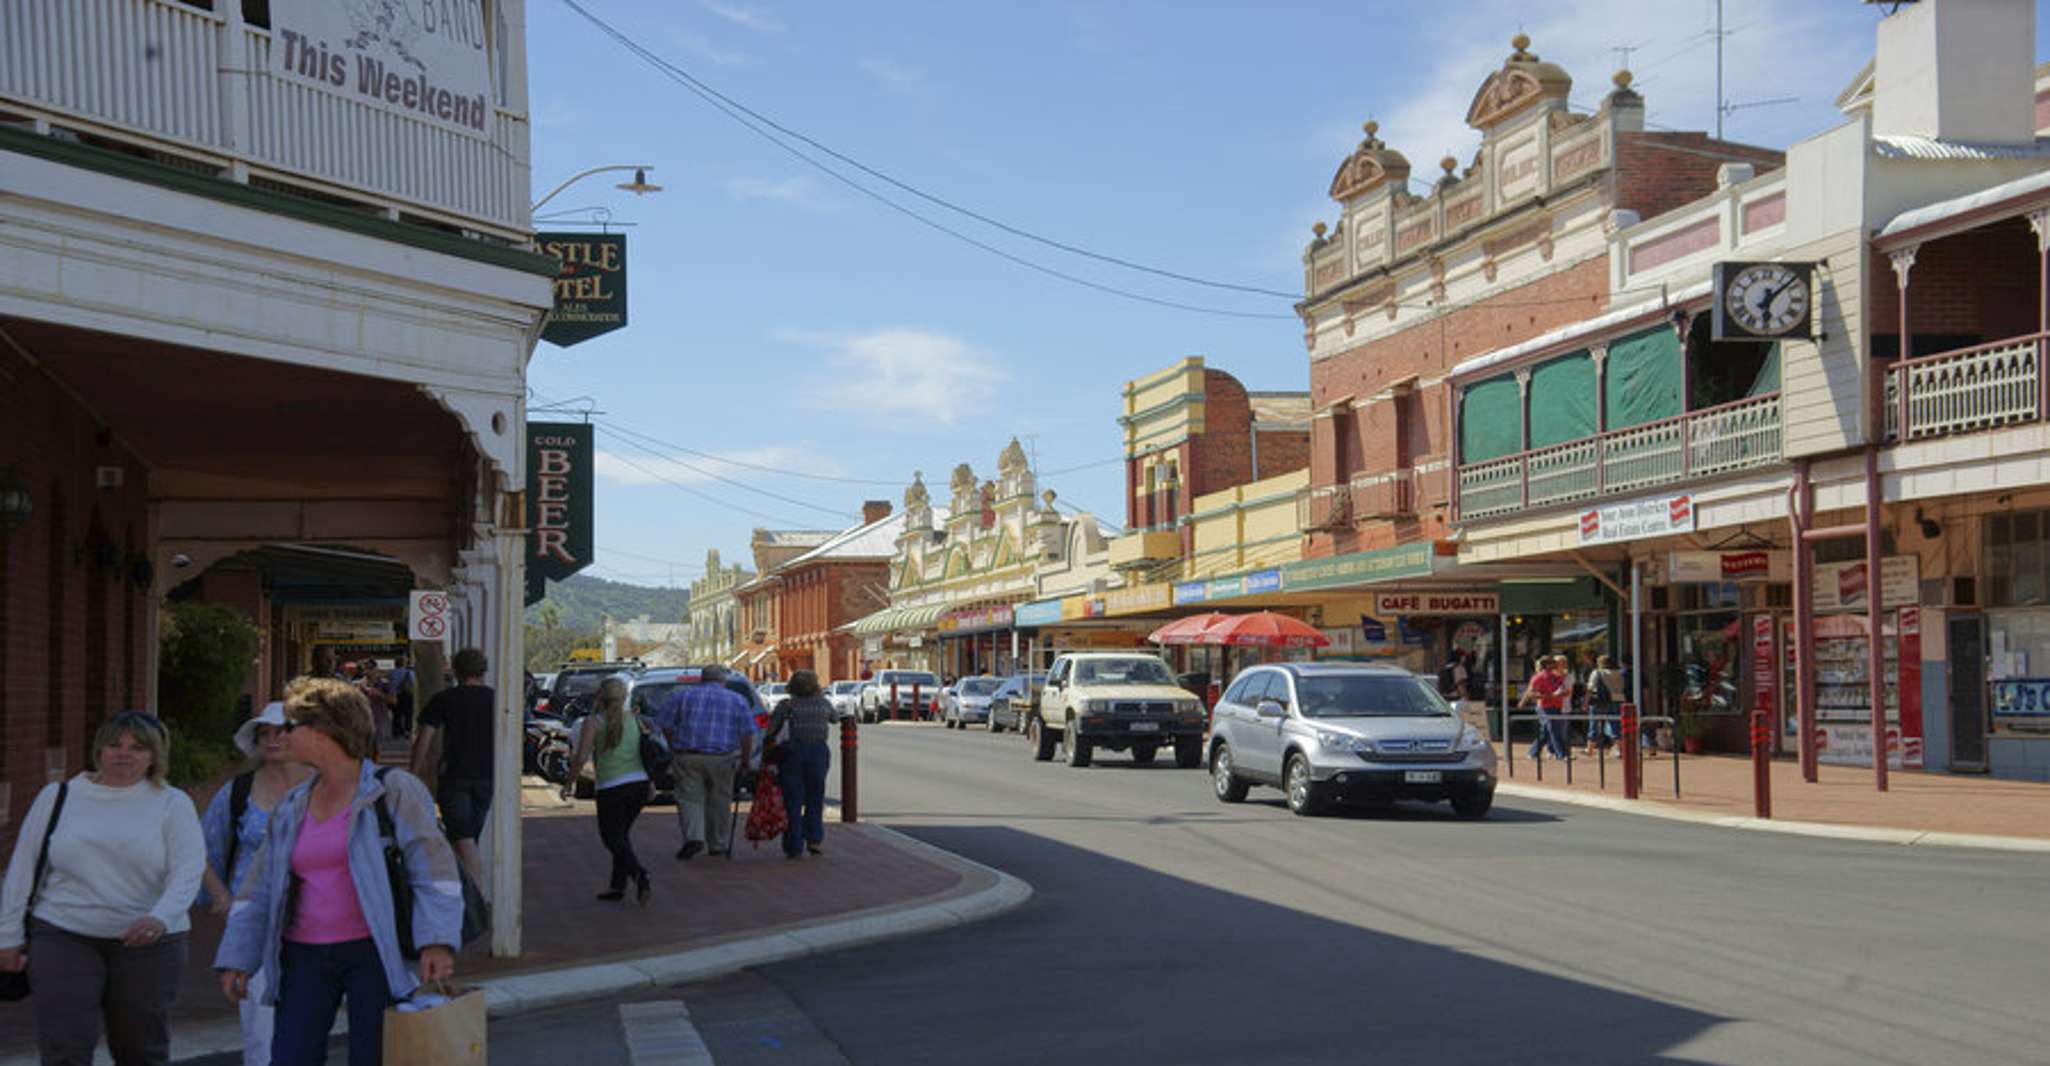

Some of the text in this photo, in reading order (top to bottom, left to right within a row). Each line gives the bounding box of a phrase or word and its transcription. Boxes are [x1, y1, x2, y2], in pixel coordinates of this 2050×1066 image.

[281, 28, 486, 131] This Weekend
[533, 242, 620, 271] ASTLE
[553, 275, 614, 300] TEL
[534, 435, 577, 445] COLD
[536, 450, 577, 564] BEER
[1429, 597, 1496, 610] BUGATTI
